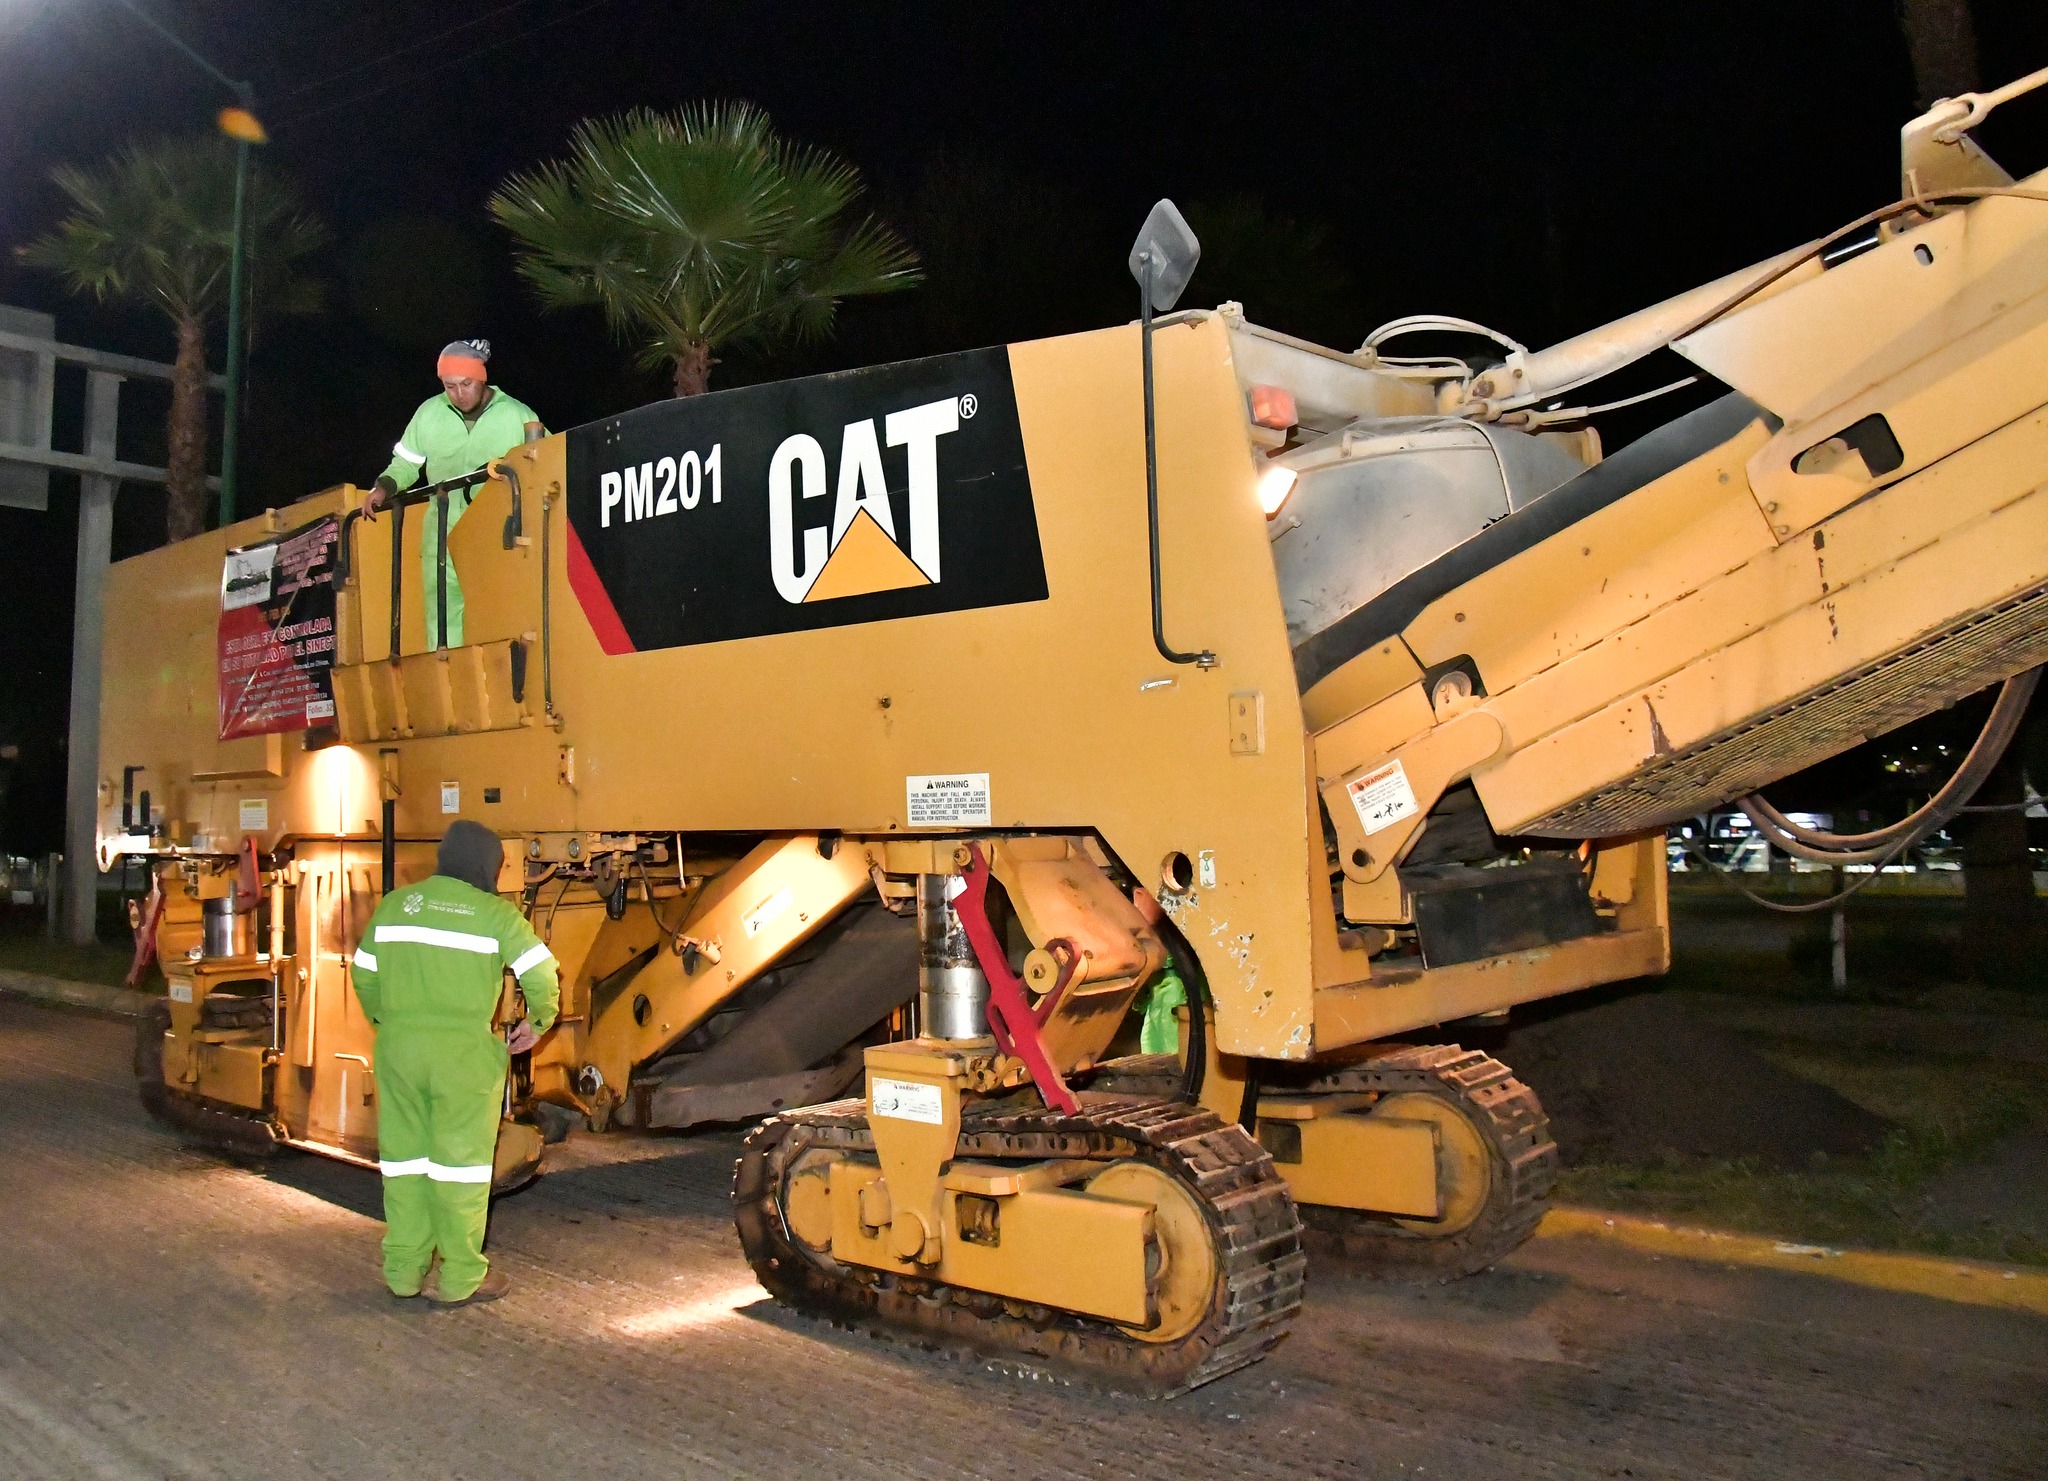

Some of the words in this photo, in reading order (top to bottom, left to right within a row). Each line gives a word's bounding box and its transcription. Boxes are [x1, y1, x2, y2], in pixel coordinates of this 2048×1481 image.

[600, 443, 722, 529] PM201
[242, 647, 279, 669] TOTAAD
[935, 780, 968, 788] WARNING
[1364, 768, 1394, 786] WARNING
